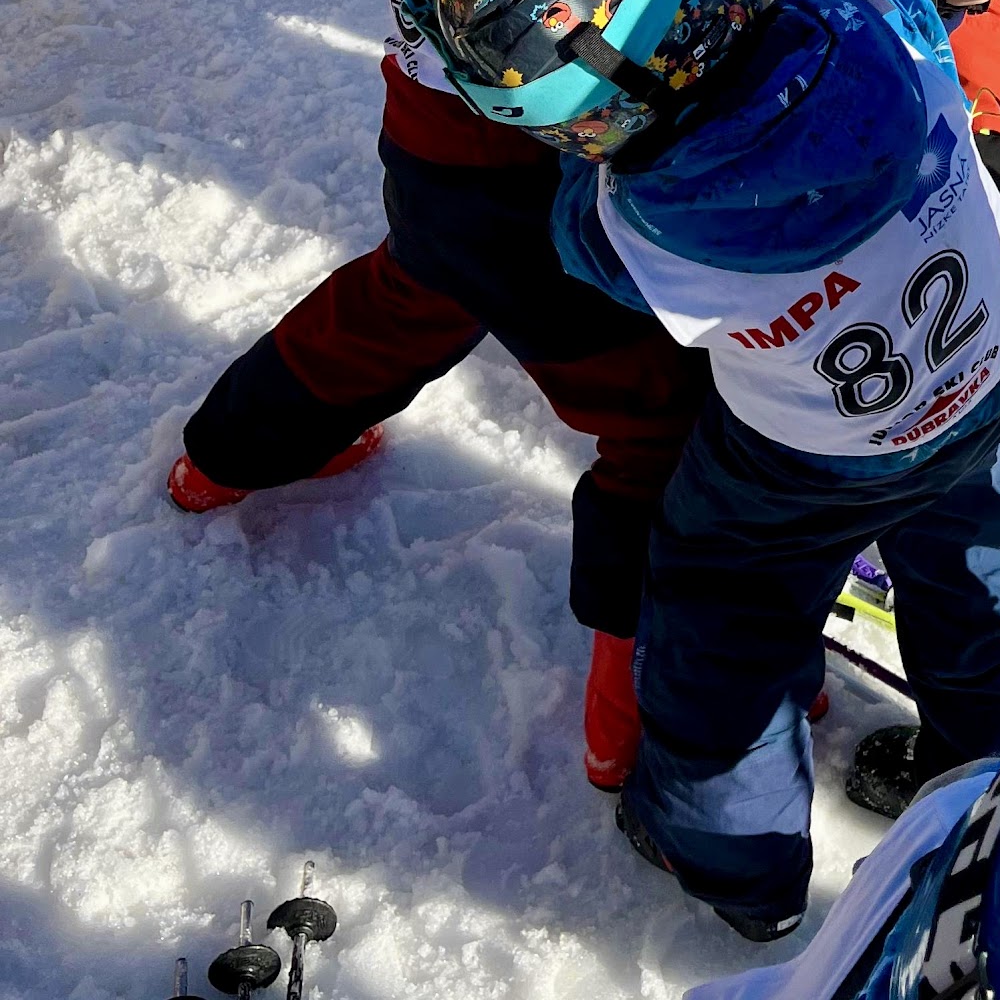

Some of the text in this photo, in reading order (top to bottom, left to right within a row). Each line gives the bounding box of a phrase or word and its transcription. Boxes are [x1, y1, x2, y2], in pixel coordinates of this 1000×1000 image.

[917, 154, 967, 236] JASNÁ
[727, 270, 862, 350] IMPA
[812, 248, 990, 419] 82
[932, 370, 965, 399] SKI
